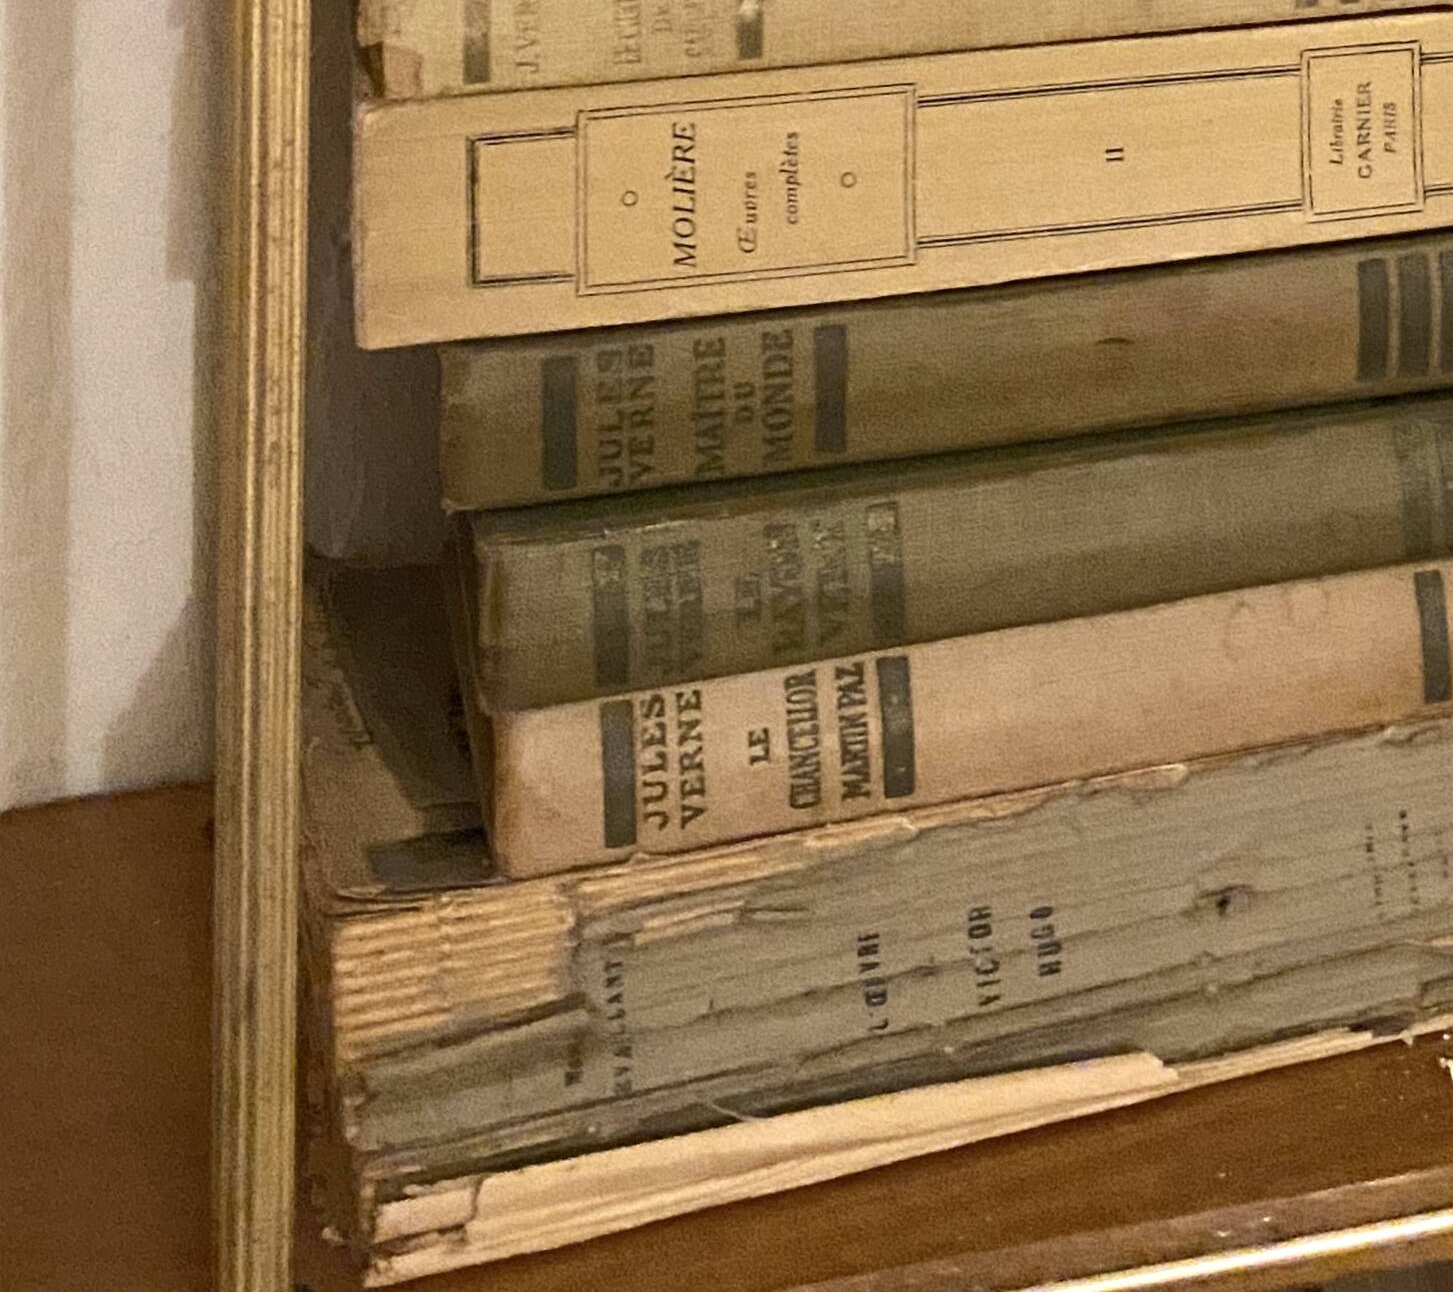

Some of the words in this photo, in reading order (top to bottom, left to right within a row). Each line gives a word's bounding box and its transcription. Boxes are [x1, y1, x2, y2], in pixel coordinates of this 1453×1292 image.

[1105, 146, 1126, 163] II
[1357, 81, 1374, 180] GARNIER
[1382, 100, 1399, 155] PARIS
[664, 122, 698, 268] MOLIÈRE
[777, 130, 802, 227] complètes
[760, 327, 796, 463] MONDE
[834, 661, 868, 713] PAZ
[639, 692, 669, 831] JULES
[675, 689, 707, 830] VERNE
[748, 727, 771, 767] LE
[839, 713, 872, 803] MARTIN
[1029, 905, 1065, 977] HUGO
